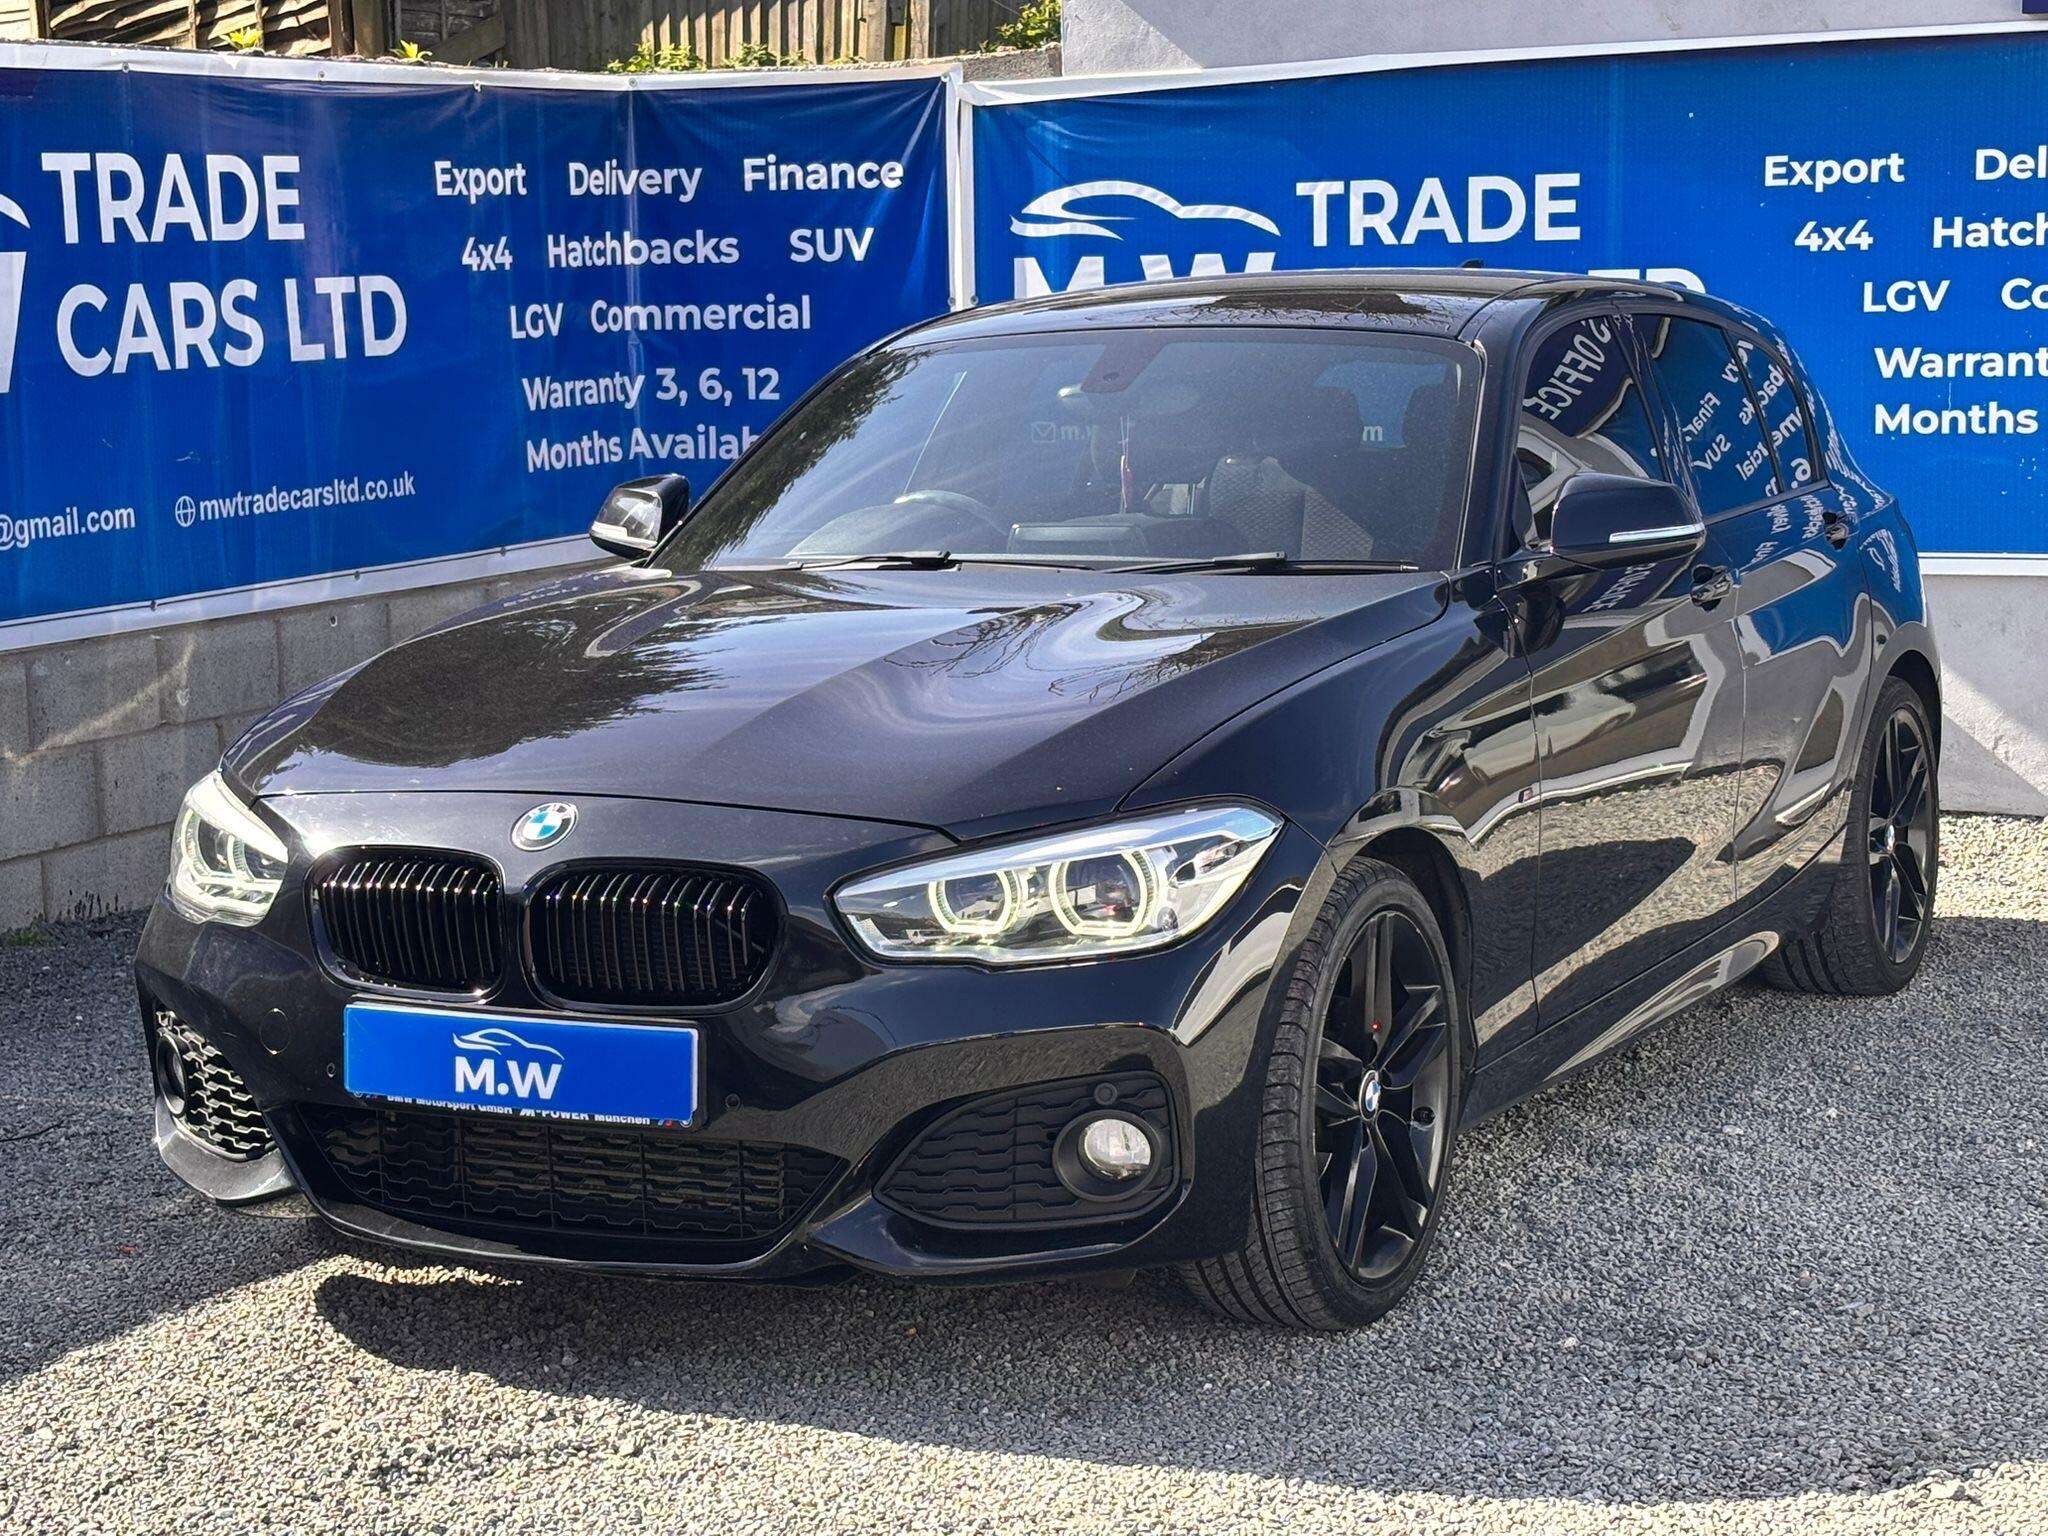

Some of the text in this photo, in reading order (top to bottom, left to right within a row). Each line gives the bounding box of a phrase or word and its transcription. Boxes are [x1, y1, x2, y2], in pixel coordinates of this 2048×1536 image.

[435, 154, 903, 204] Export Delivery Finance
[1765, 153, 1905, 192] Export
[42, 153, 305, 243] TRADE
[1296, 173, 1580, 246] TRADE
[462, 227, 874, 271] 4x4 Hatchbacks SUV
[1795, 220, 1873, 251] 4x4
[511, 294, 810, 338] LGV Commercial
[1864, 280, 1950, 312] LGV
[57, 279, 264, 376] CARS
[285, 275, 406, 361] LTD
[522, 368, 779, 410] Warranty 3, 6, 12
[1875, 402, 2038, 434] Months
[527, 431, 622, 472] Months
[200, 471, 415, 520] mwtradecarsltd.co.uk
